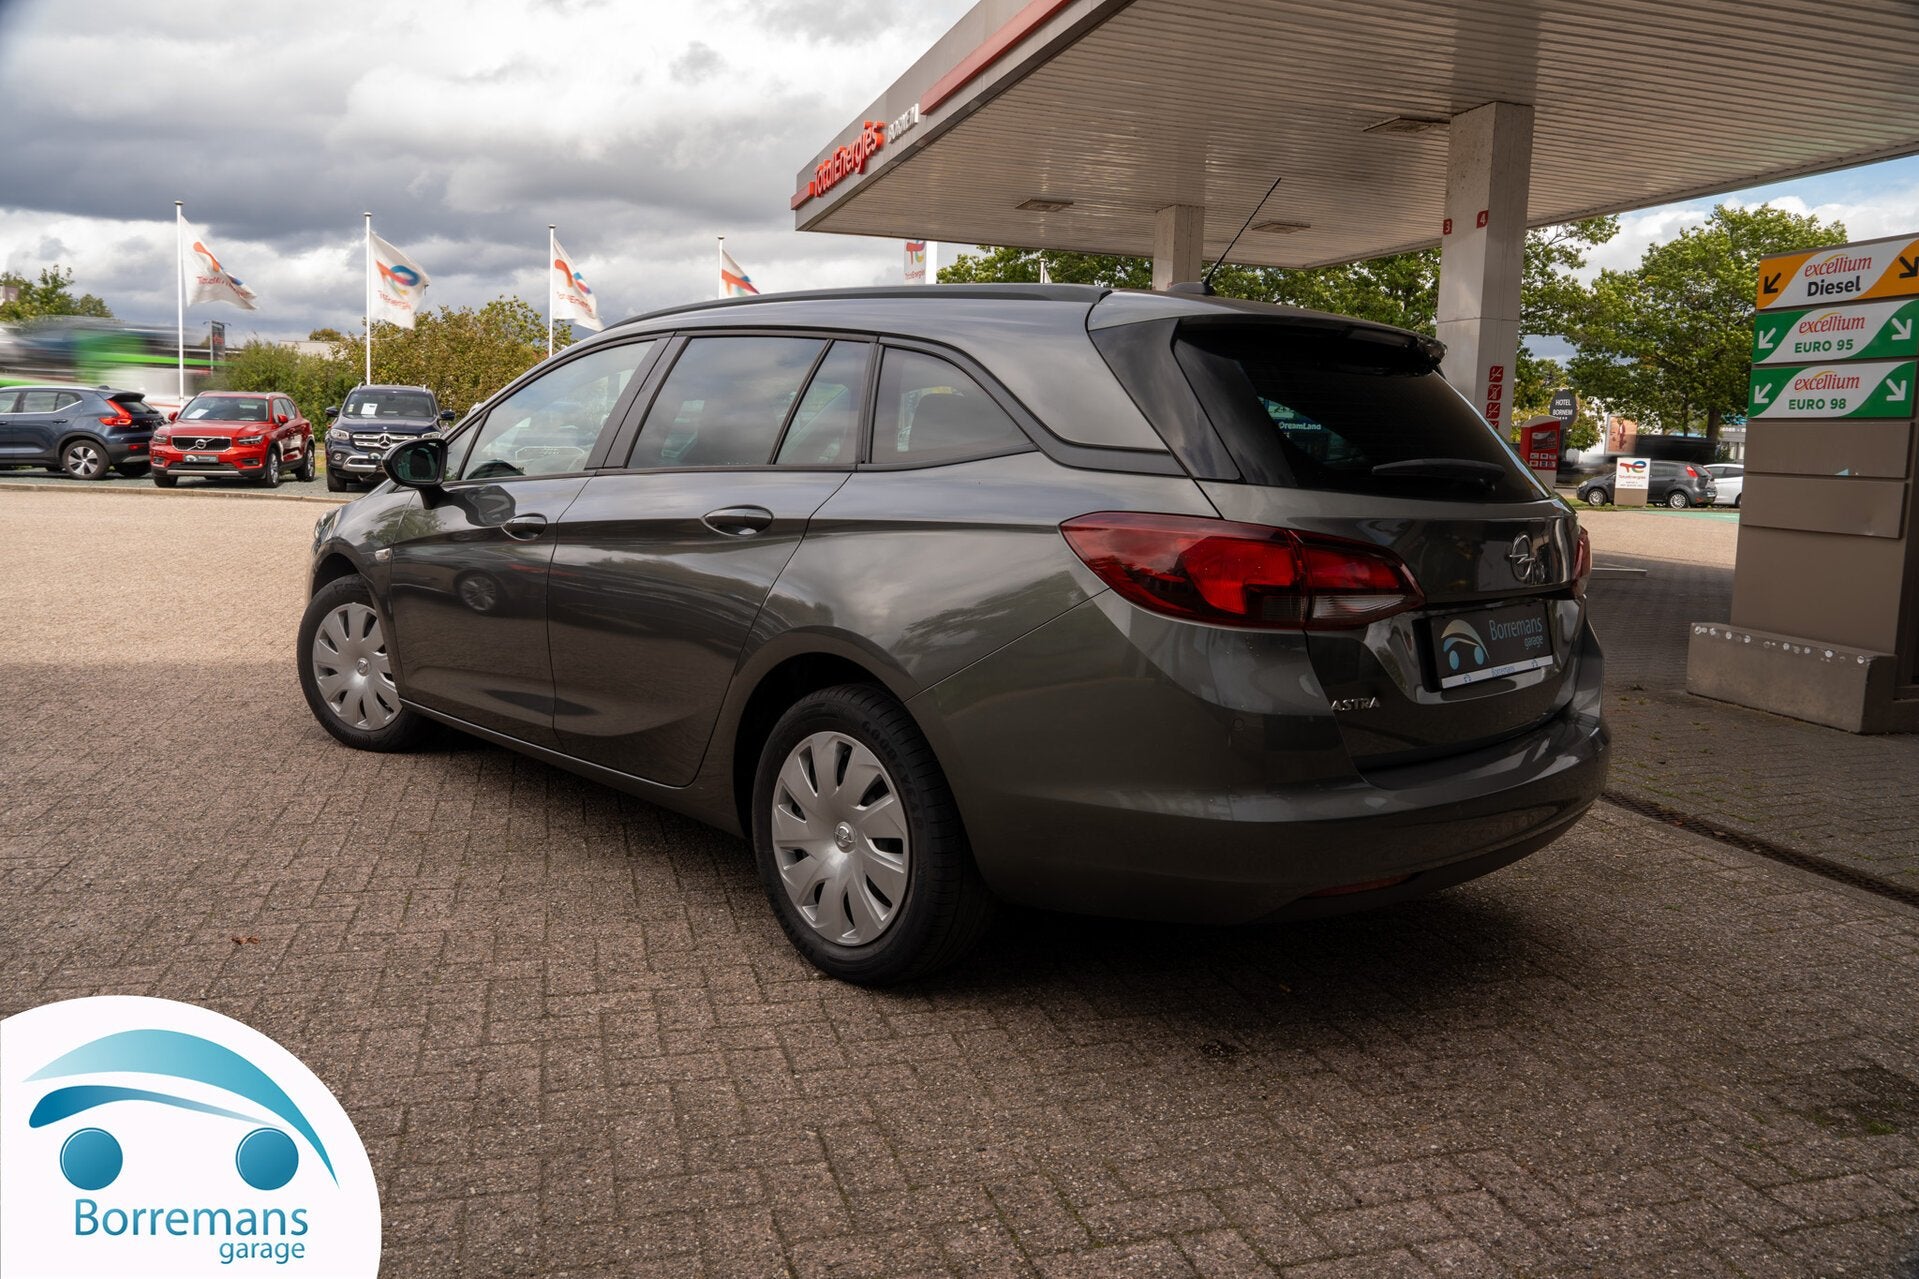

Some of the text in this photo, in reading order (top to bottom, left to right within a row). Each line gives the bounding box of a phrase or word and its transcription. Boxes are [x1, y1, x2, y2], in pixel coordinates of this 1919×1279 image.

[815, 121, 886, 198] TotalEnergies
[1804, 254, 1872, 277] excellium
[1807, 275, 1861, 297] Diesel
[1799, 314, 1865, 334] excellium
[1794, 339, 1854, 354] EURO 95
[1794, 372, 1860, 392] excellium
[1788, 398, 1847, 411] EURO 98
[1278, 421, 1322, 430] DreamLand
[1488, 616, 1543, 641] Borremans
[1524, 635, 1544, 650] garage
[1330, 696, 1380, 711] ASTRA
